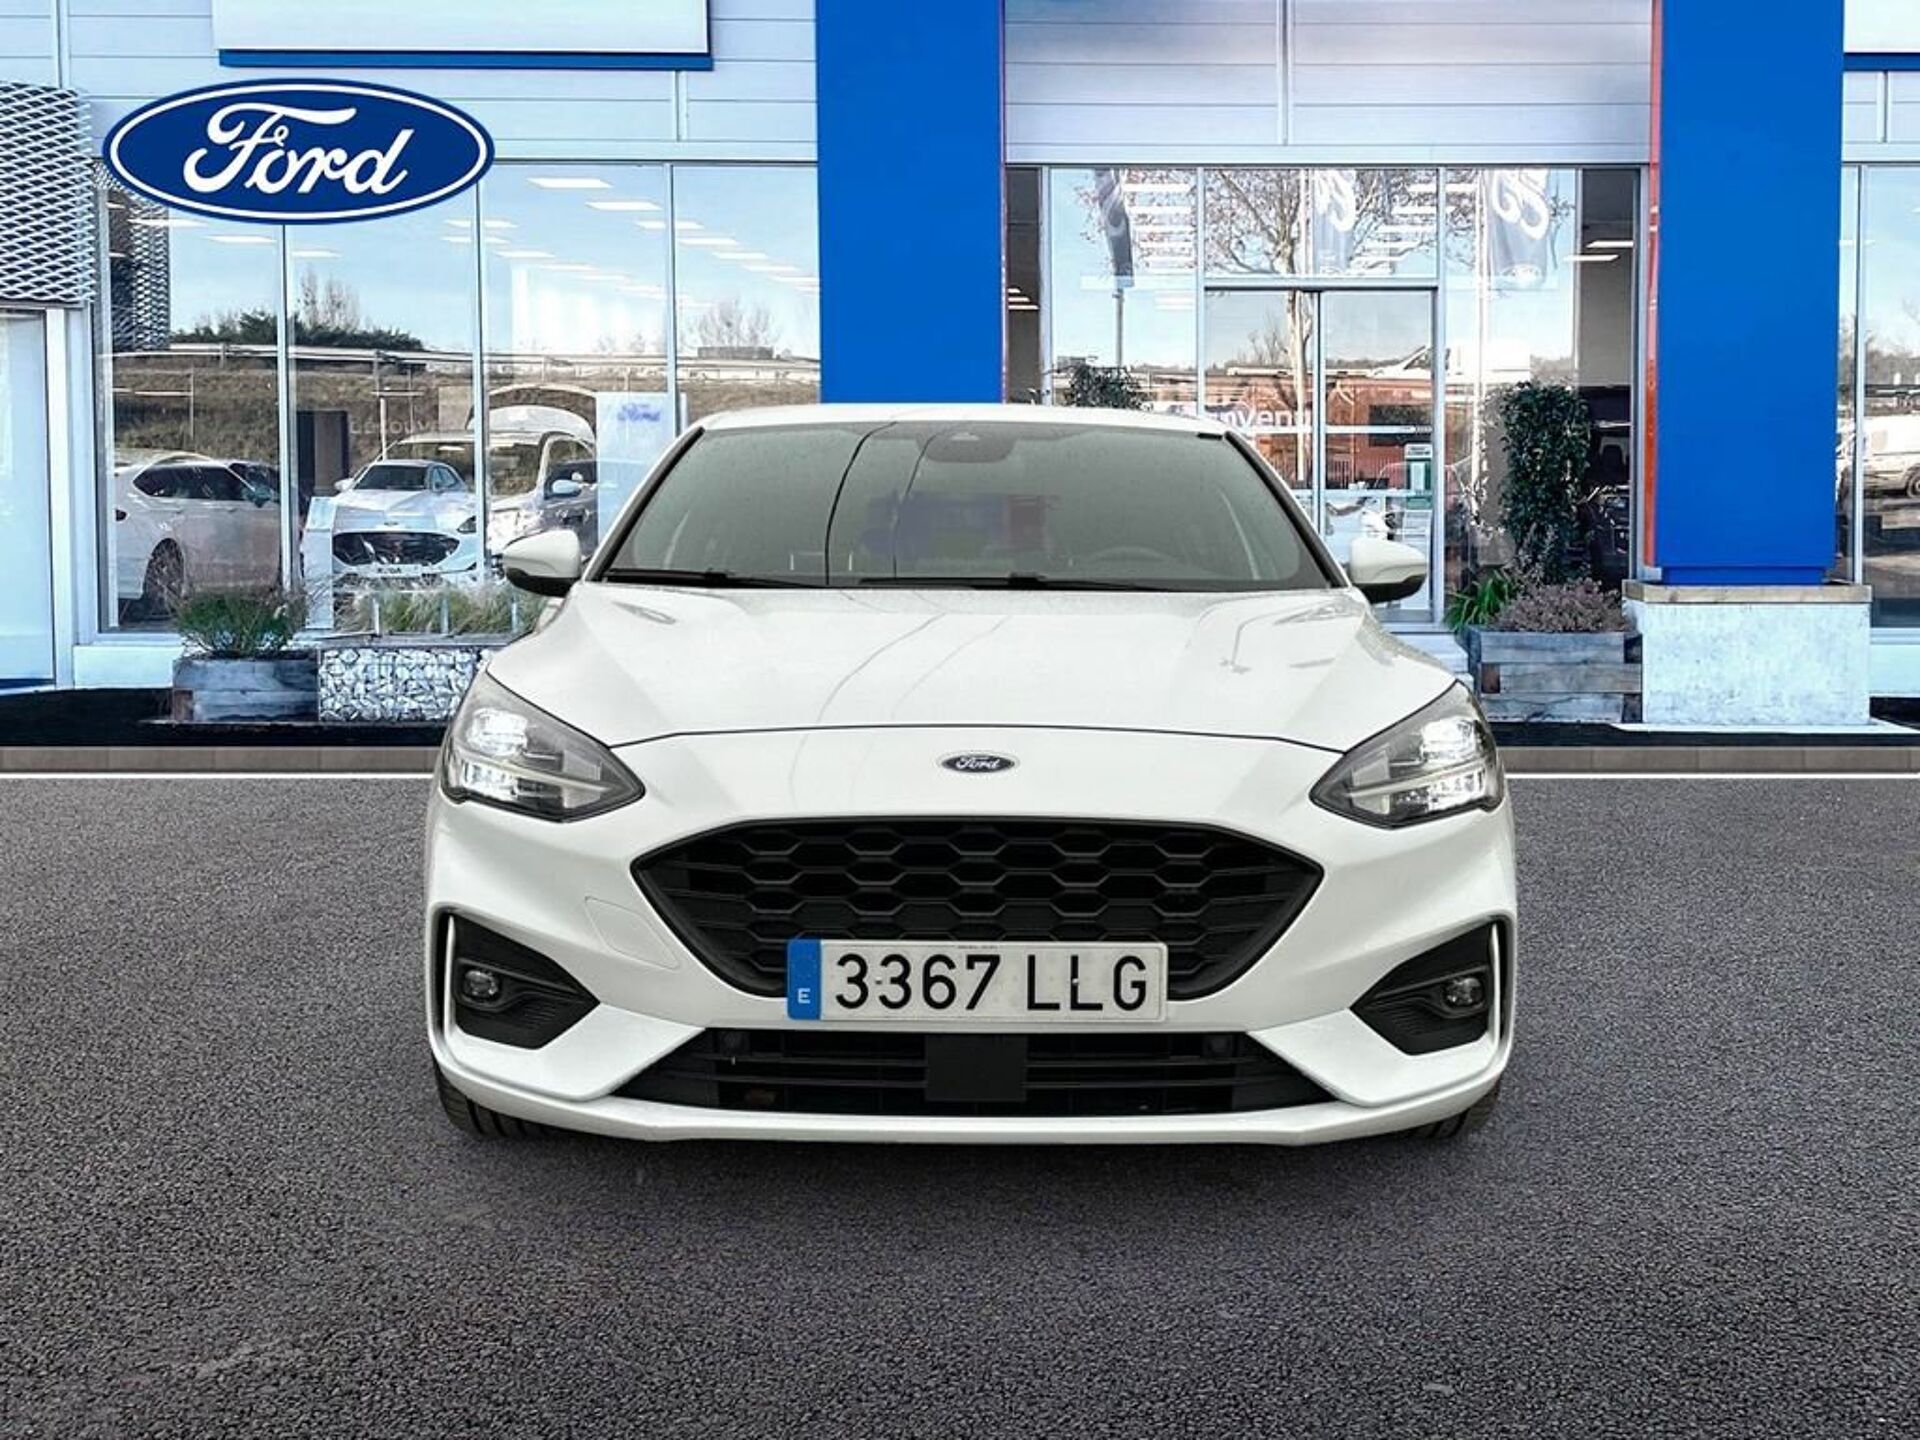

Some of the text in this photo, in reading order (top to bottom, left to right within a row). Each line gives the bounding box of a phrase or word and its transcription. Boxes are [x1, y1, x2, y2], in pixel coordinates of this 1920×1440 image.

[183, 102, 414, 195] Ford
[956, 756, 1000, 769] Ford
[797, 987, 811, 1004] E
[835, 953, 1147, 1012] 3367 LLG
